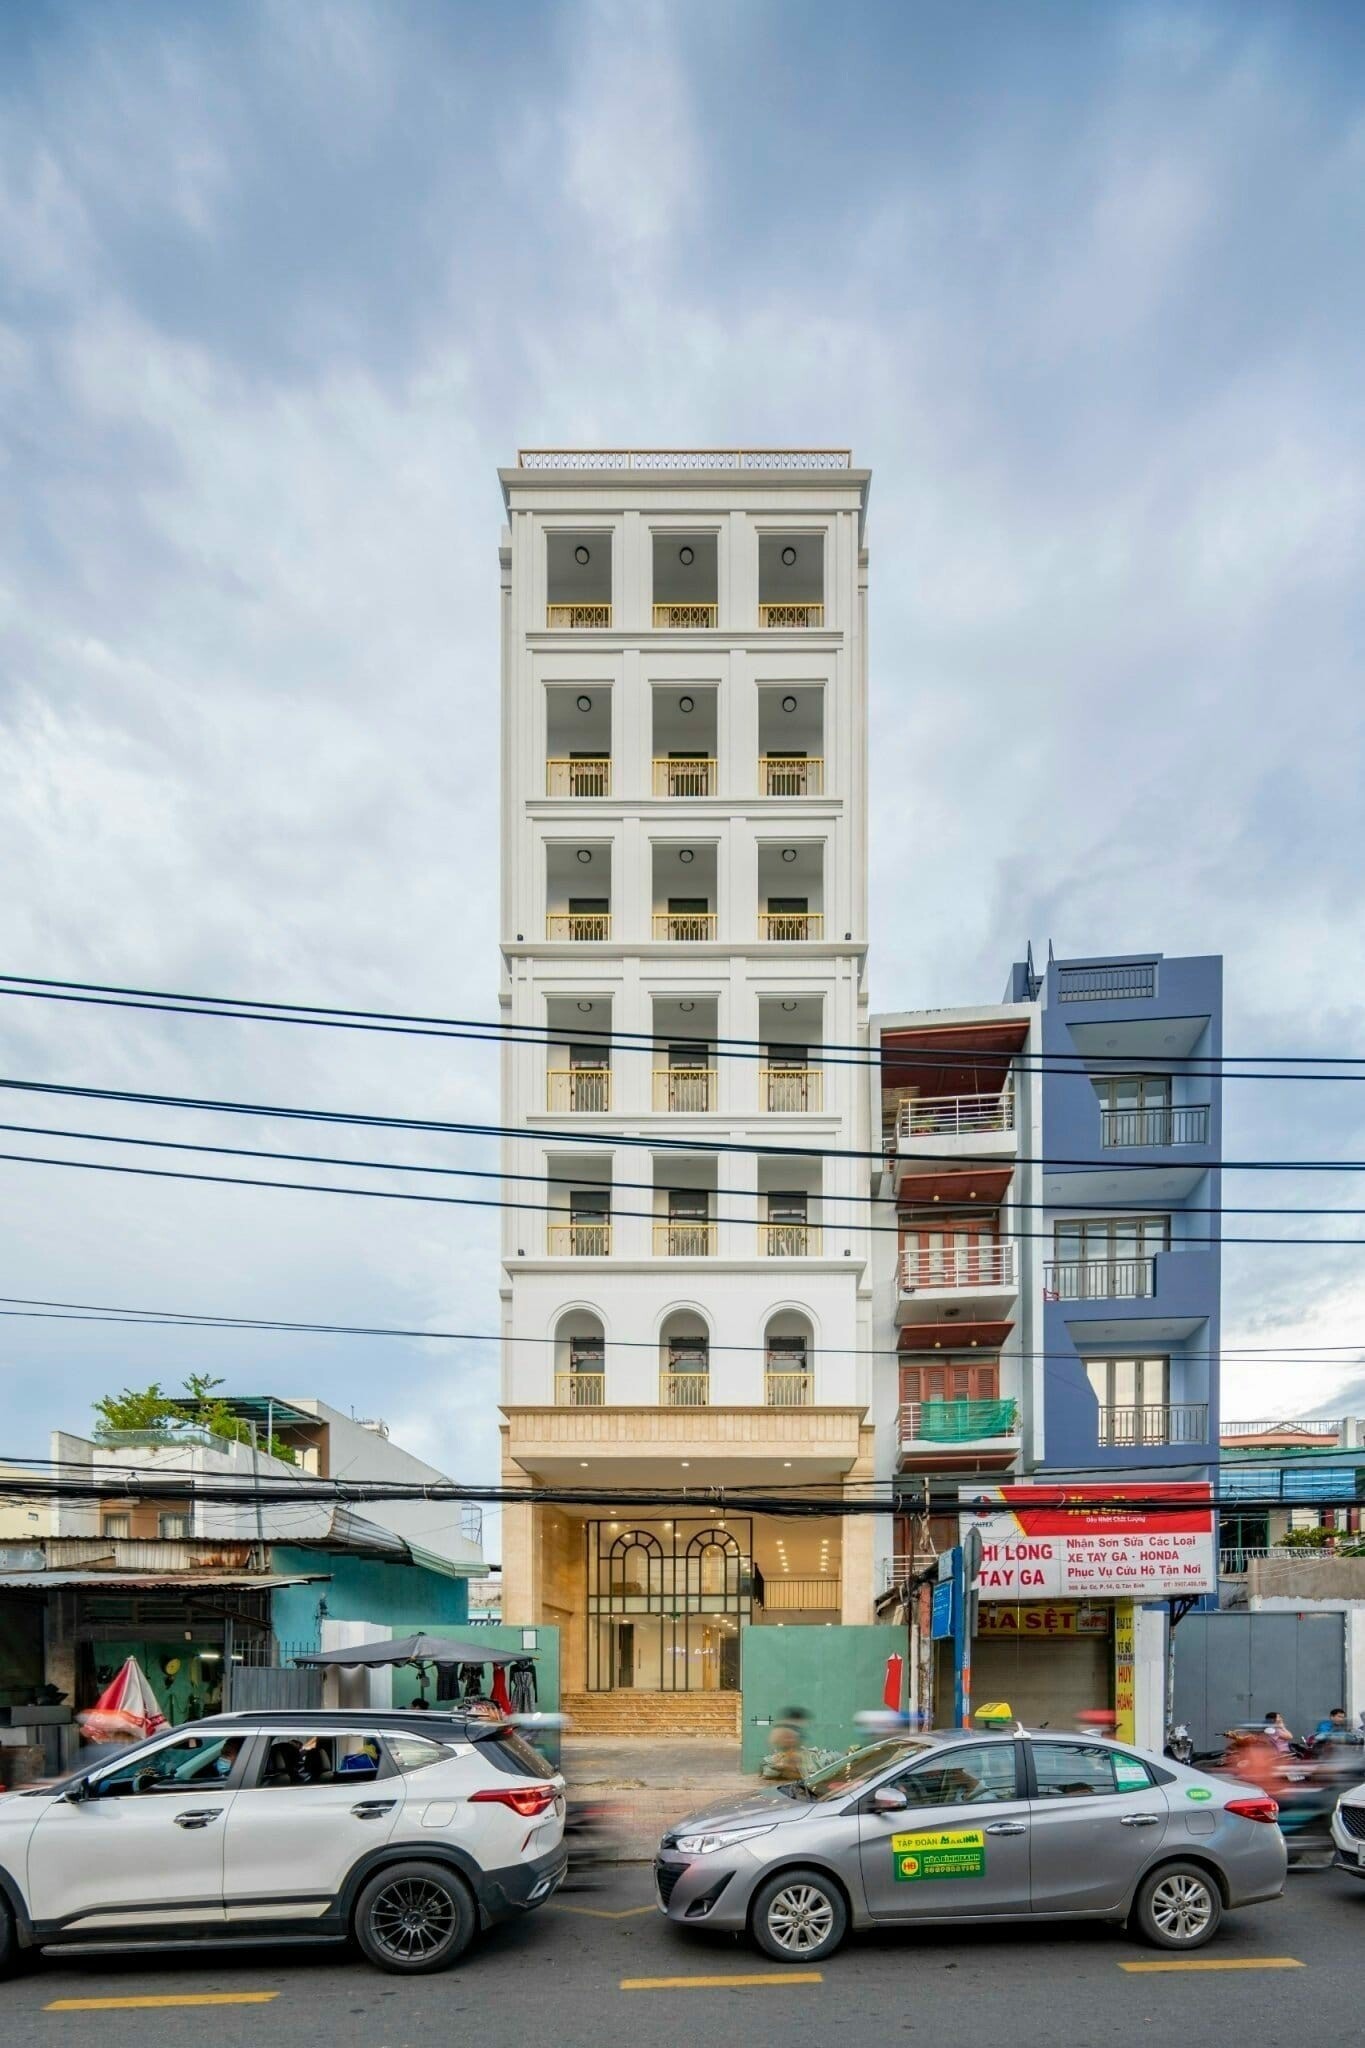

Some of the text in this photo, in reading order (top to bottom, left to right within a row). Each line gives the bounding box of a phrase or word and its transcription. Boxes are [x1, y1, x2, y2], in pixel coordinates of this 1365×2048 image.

[1066, 1535, 1196, 1550] Nhận Sơn Sửa Các Loại
[1005, 1544, 1053, 1561] LONG
[1068, 1553, 1083, 1562] XE
[1087, 1552, 1107, 1561] TAY
[1111, 1552, 1128, 1561] GA
[1140, 1550, 1179, 1561] HONDA
[978, 1570, 1045, 1586] TAY GA
[1067, 1567, 1094, 1579] Phục
[1098, 1567, 1112, 1578] Vụ
[1140, 1564, 1155, 1576] Hộ
[1025, 1607, 1075, 1632] SỆT
[1118, 1666, 1131, 1683] HUY
[903, 1861, 917, 1869] HB
